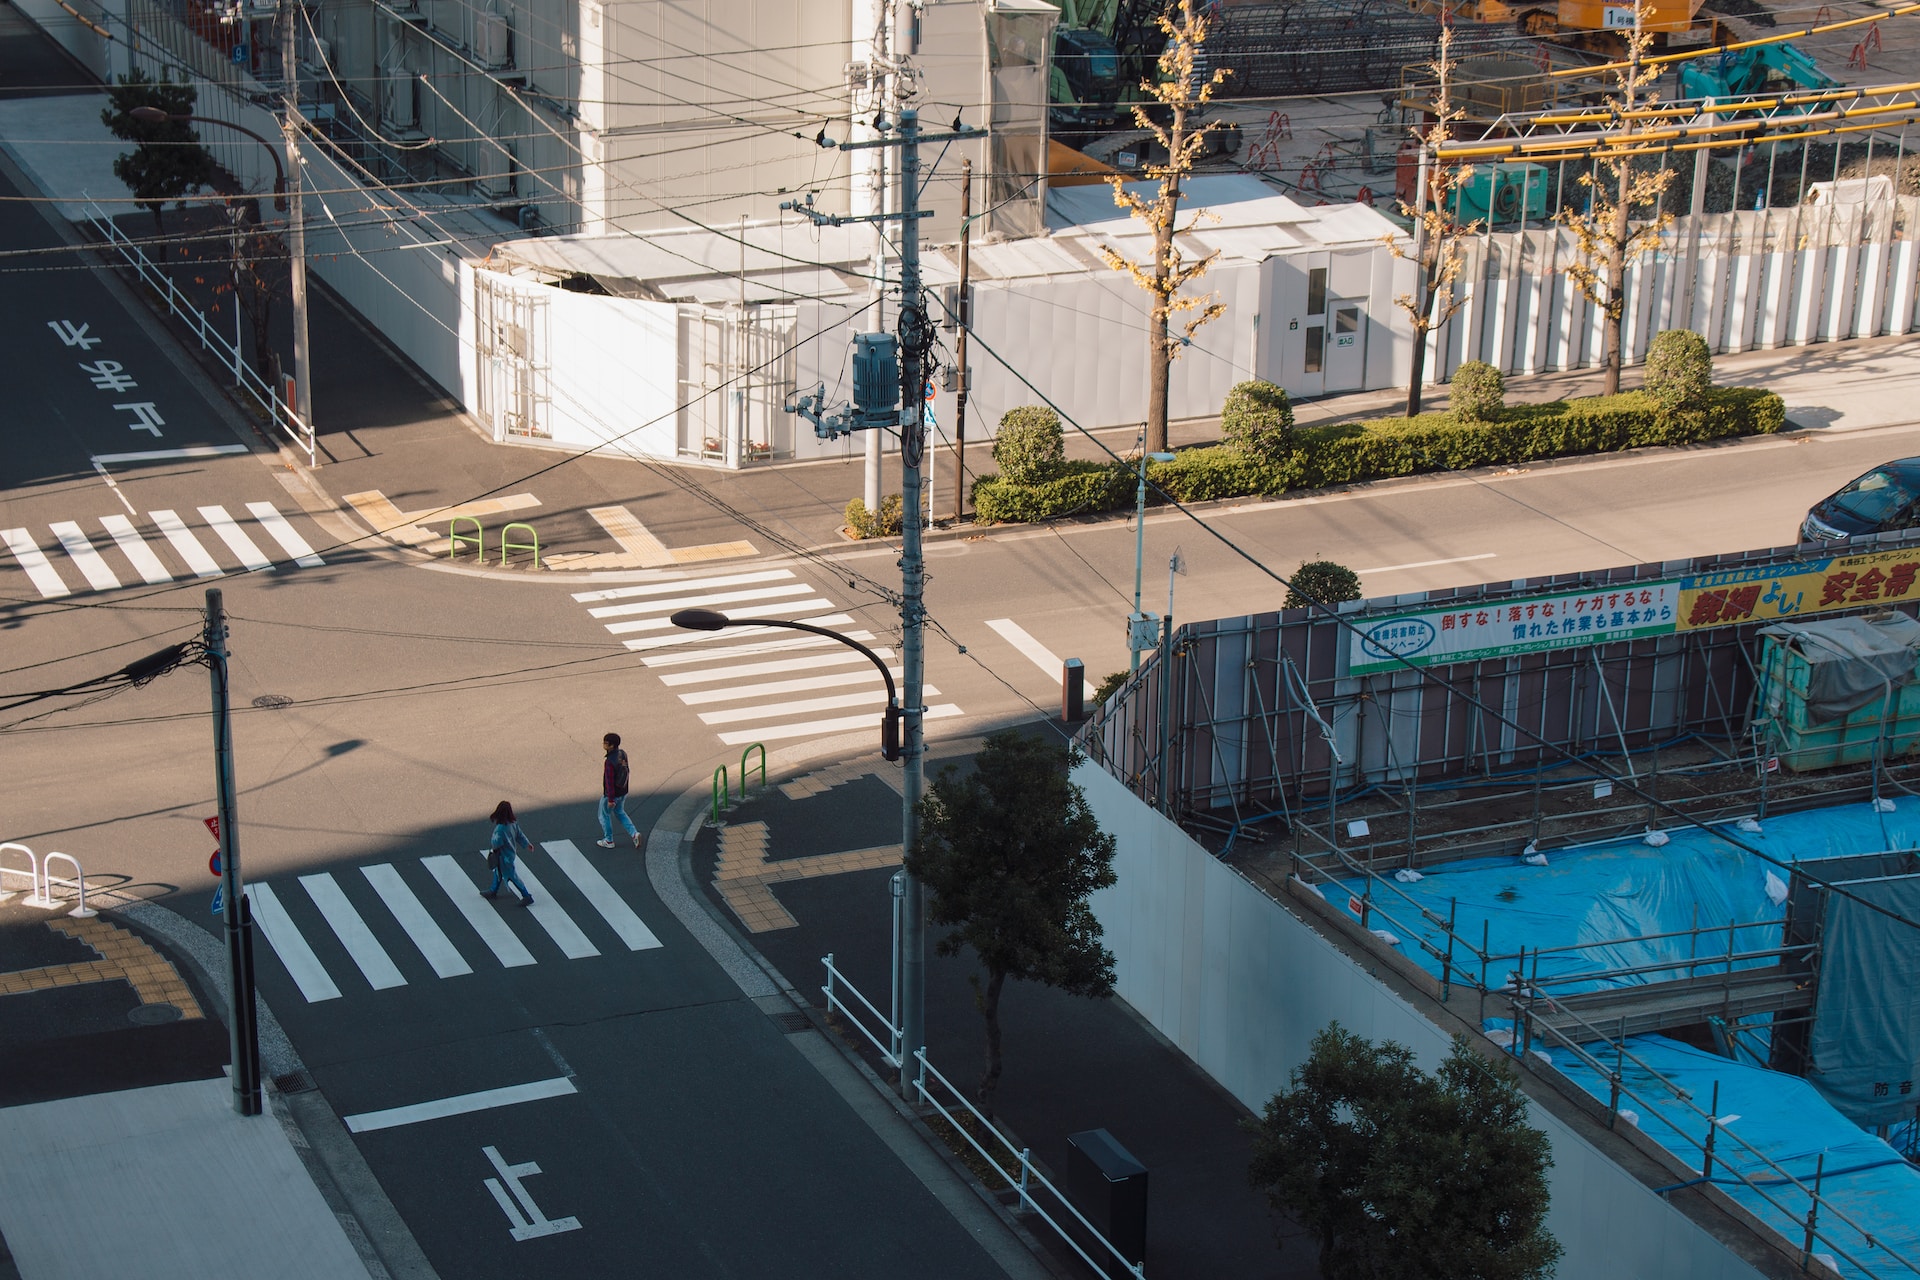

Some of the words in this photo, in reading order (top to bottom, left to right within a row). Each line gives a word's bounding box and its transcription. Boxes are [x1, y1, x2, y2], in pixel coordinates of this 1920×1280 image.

[1608, 10, 1634, 26] 1号機
[236, 47, 242, 62] 9
[47, 320, 166, 437] 止まれ
[1819, 562, 1920, 607] 安全帯
[1512, 605, 1672, 640] 慣れた作業も基本から
[1373, 624, 1425, 641] 重機災害防止
[1873, 1080, 1913, 1097] 防音
